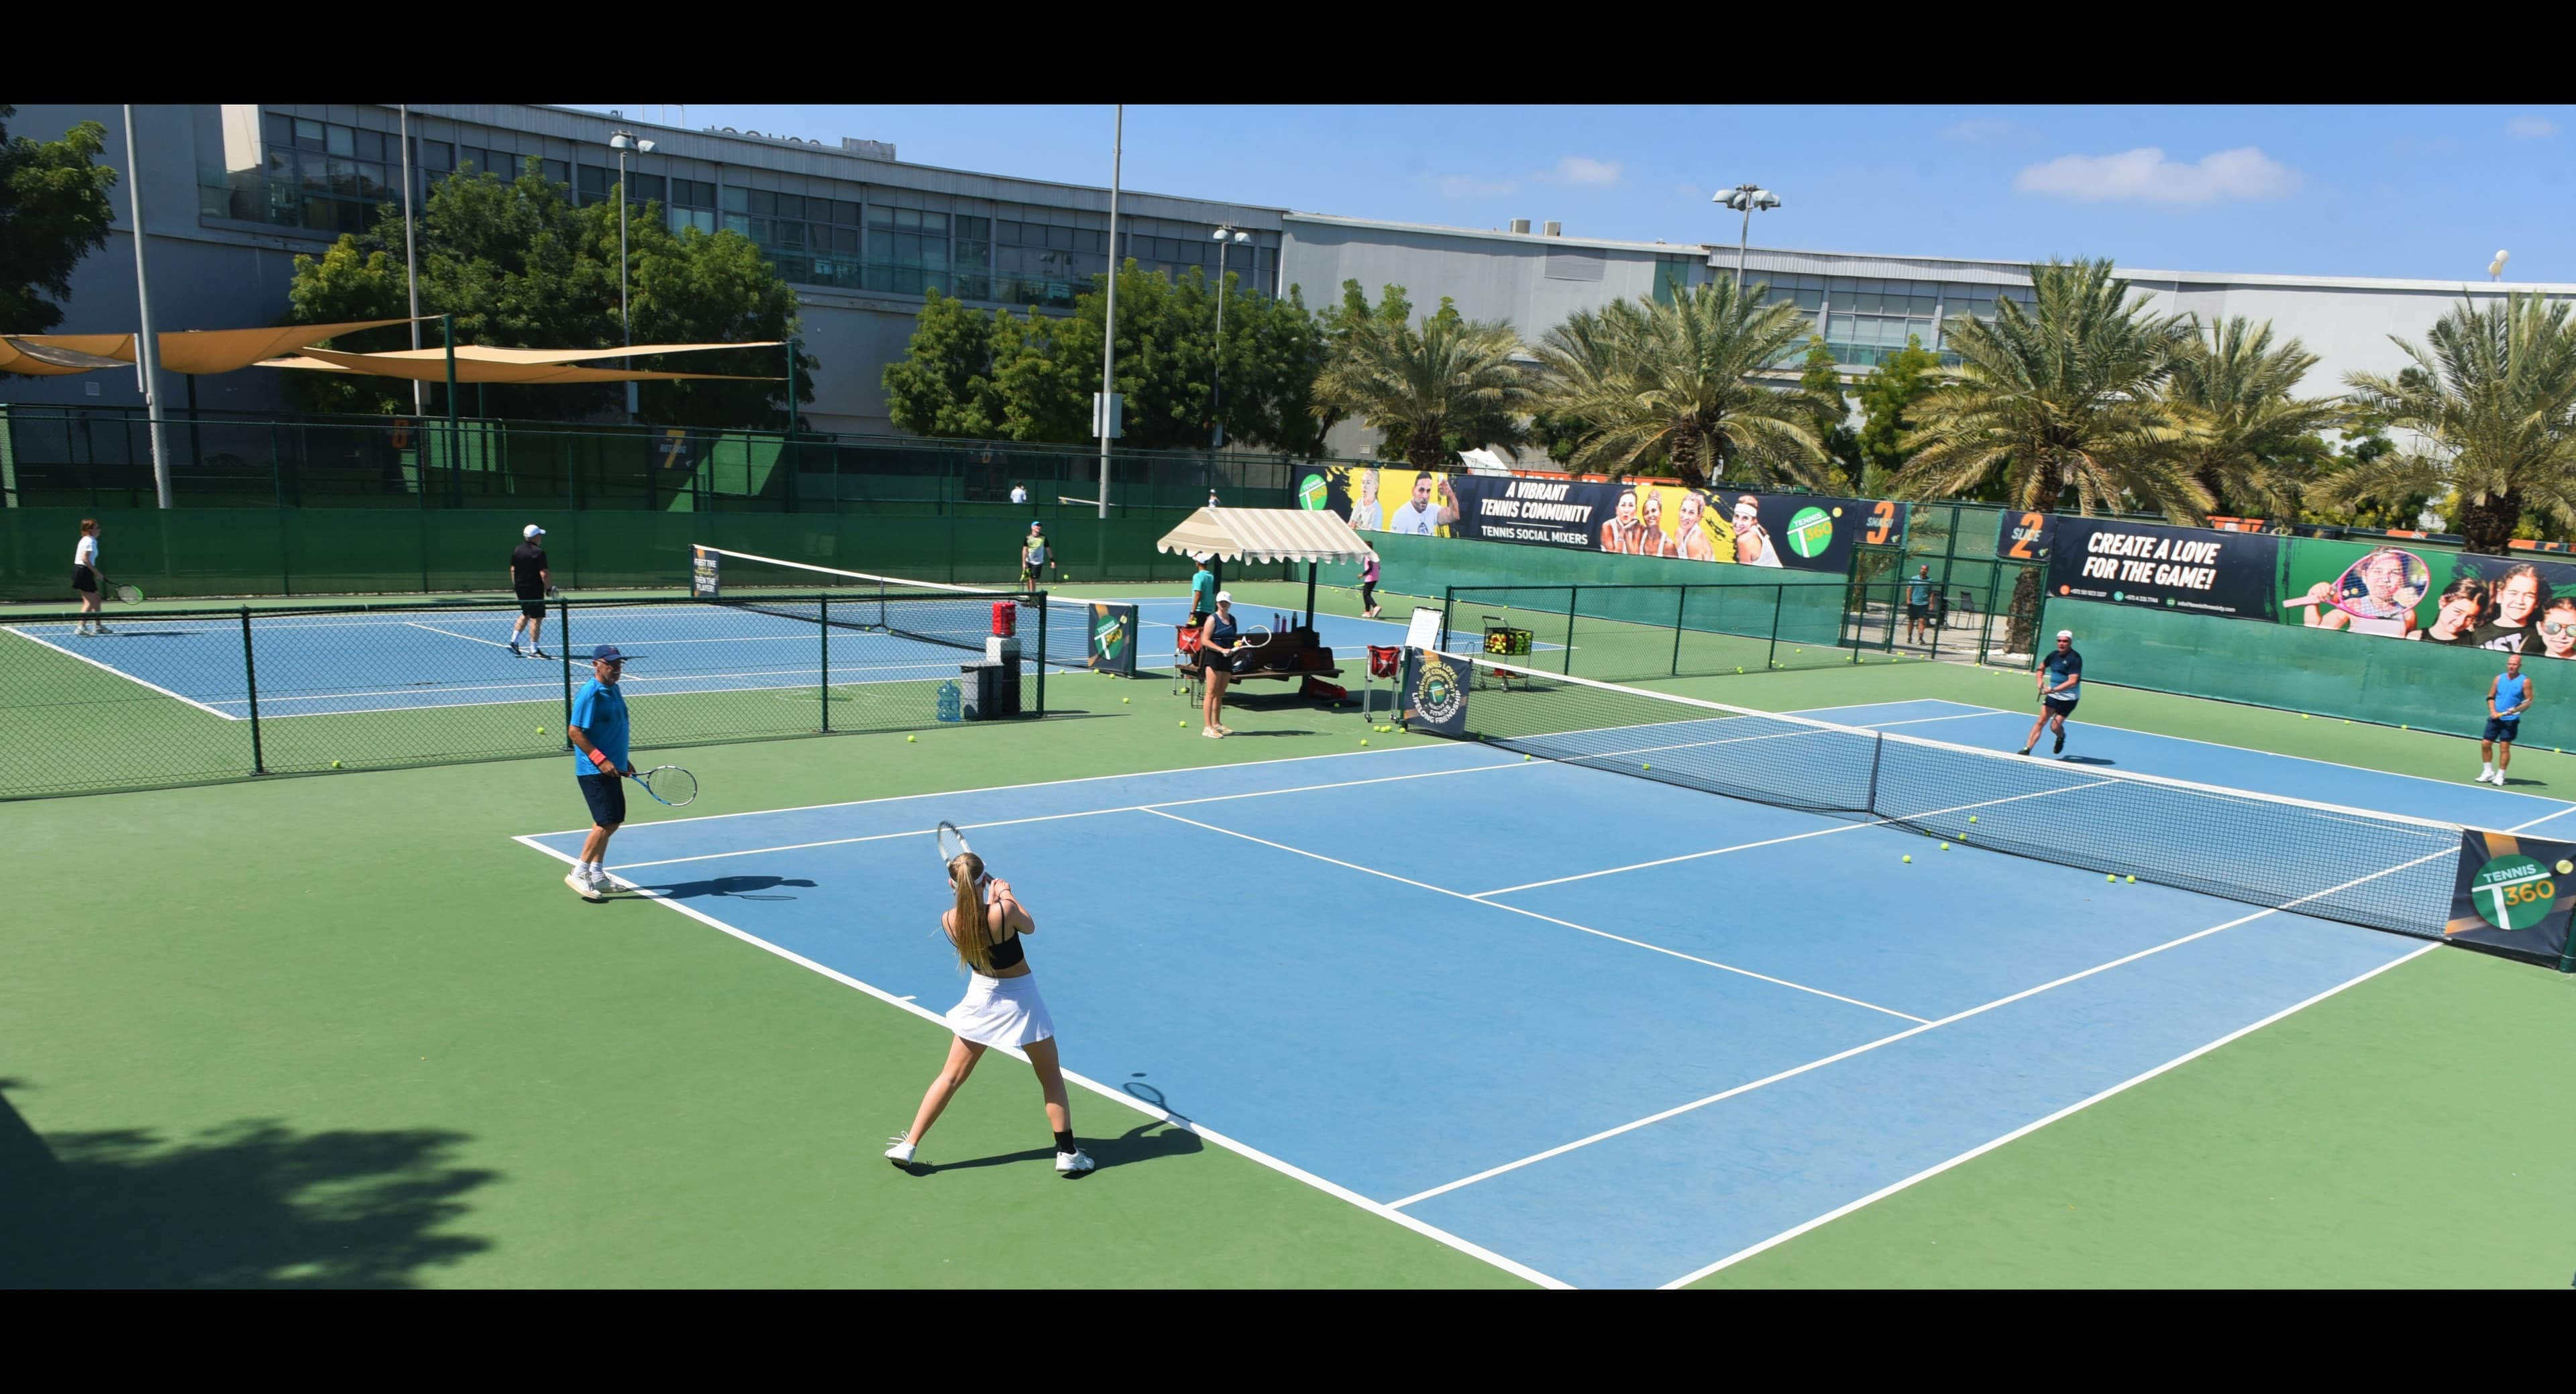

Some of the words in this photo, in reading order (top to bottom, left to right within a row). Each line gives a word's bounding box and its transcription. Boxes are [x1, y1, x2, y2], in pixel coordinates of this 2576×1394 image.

[664, 429, 686, 468] 7
[1303, 478, 1321, 490] TENNIS
[1505, 481, 1517, 498] A
[1517, 482, 1570, 501] VIBRANT
[1481, 499, 1520, 518] TENNIS
[1521, 502, 1593, 523] COMMUNITY
[1793, 512, 1823, 527] TENNIS
[1805, 522, 1833, 541] 360
[1866, 500, 1894, 544] 3
[1866, 517, 1894, 528] SMASH
[1481, 526, 1515, 539] TENNIS
[1516, 529, 1550, 541] SOCIAL
[1552, 531, 1589, 545] MIXERS
[2008, 512, 2044, 558] 2
[2011, 527, 2043, 542] SLICE
[2088, 532, 2157, 558] CREATE
[2153, 539, 2171, 560] A
[2170, 539, 2222, 565] LOVE
[2082, 556, 2119, 580] FOR
[2120, 559, 2157, 584] THE
[2154, 564, 2217, 590] GAME!
[1097, 620, 1116, 633] TENNIS
[1419, 661, 1442, 674] TENNIS
[1442, 663, 1458, 681] LOVE
[1419, 672, 1431, 699] SERVING
[1432, 669, 1455, 697] COMMUNITY
[1412, 692, 1434, 723] LIFELONG
[1436, 690, 1461, 724] FRIENDSHIP
[1430, 704, 1451, 716] FITNESS
[2483, 864, 2537, 883] TENNIS
[2504, 880, 2555, 906] 360
